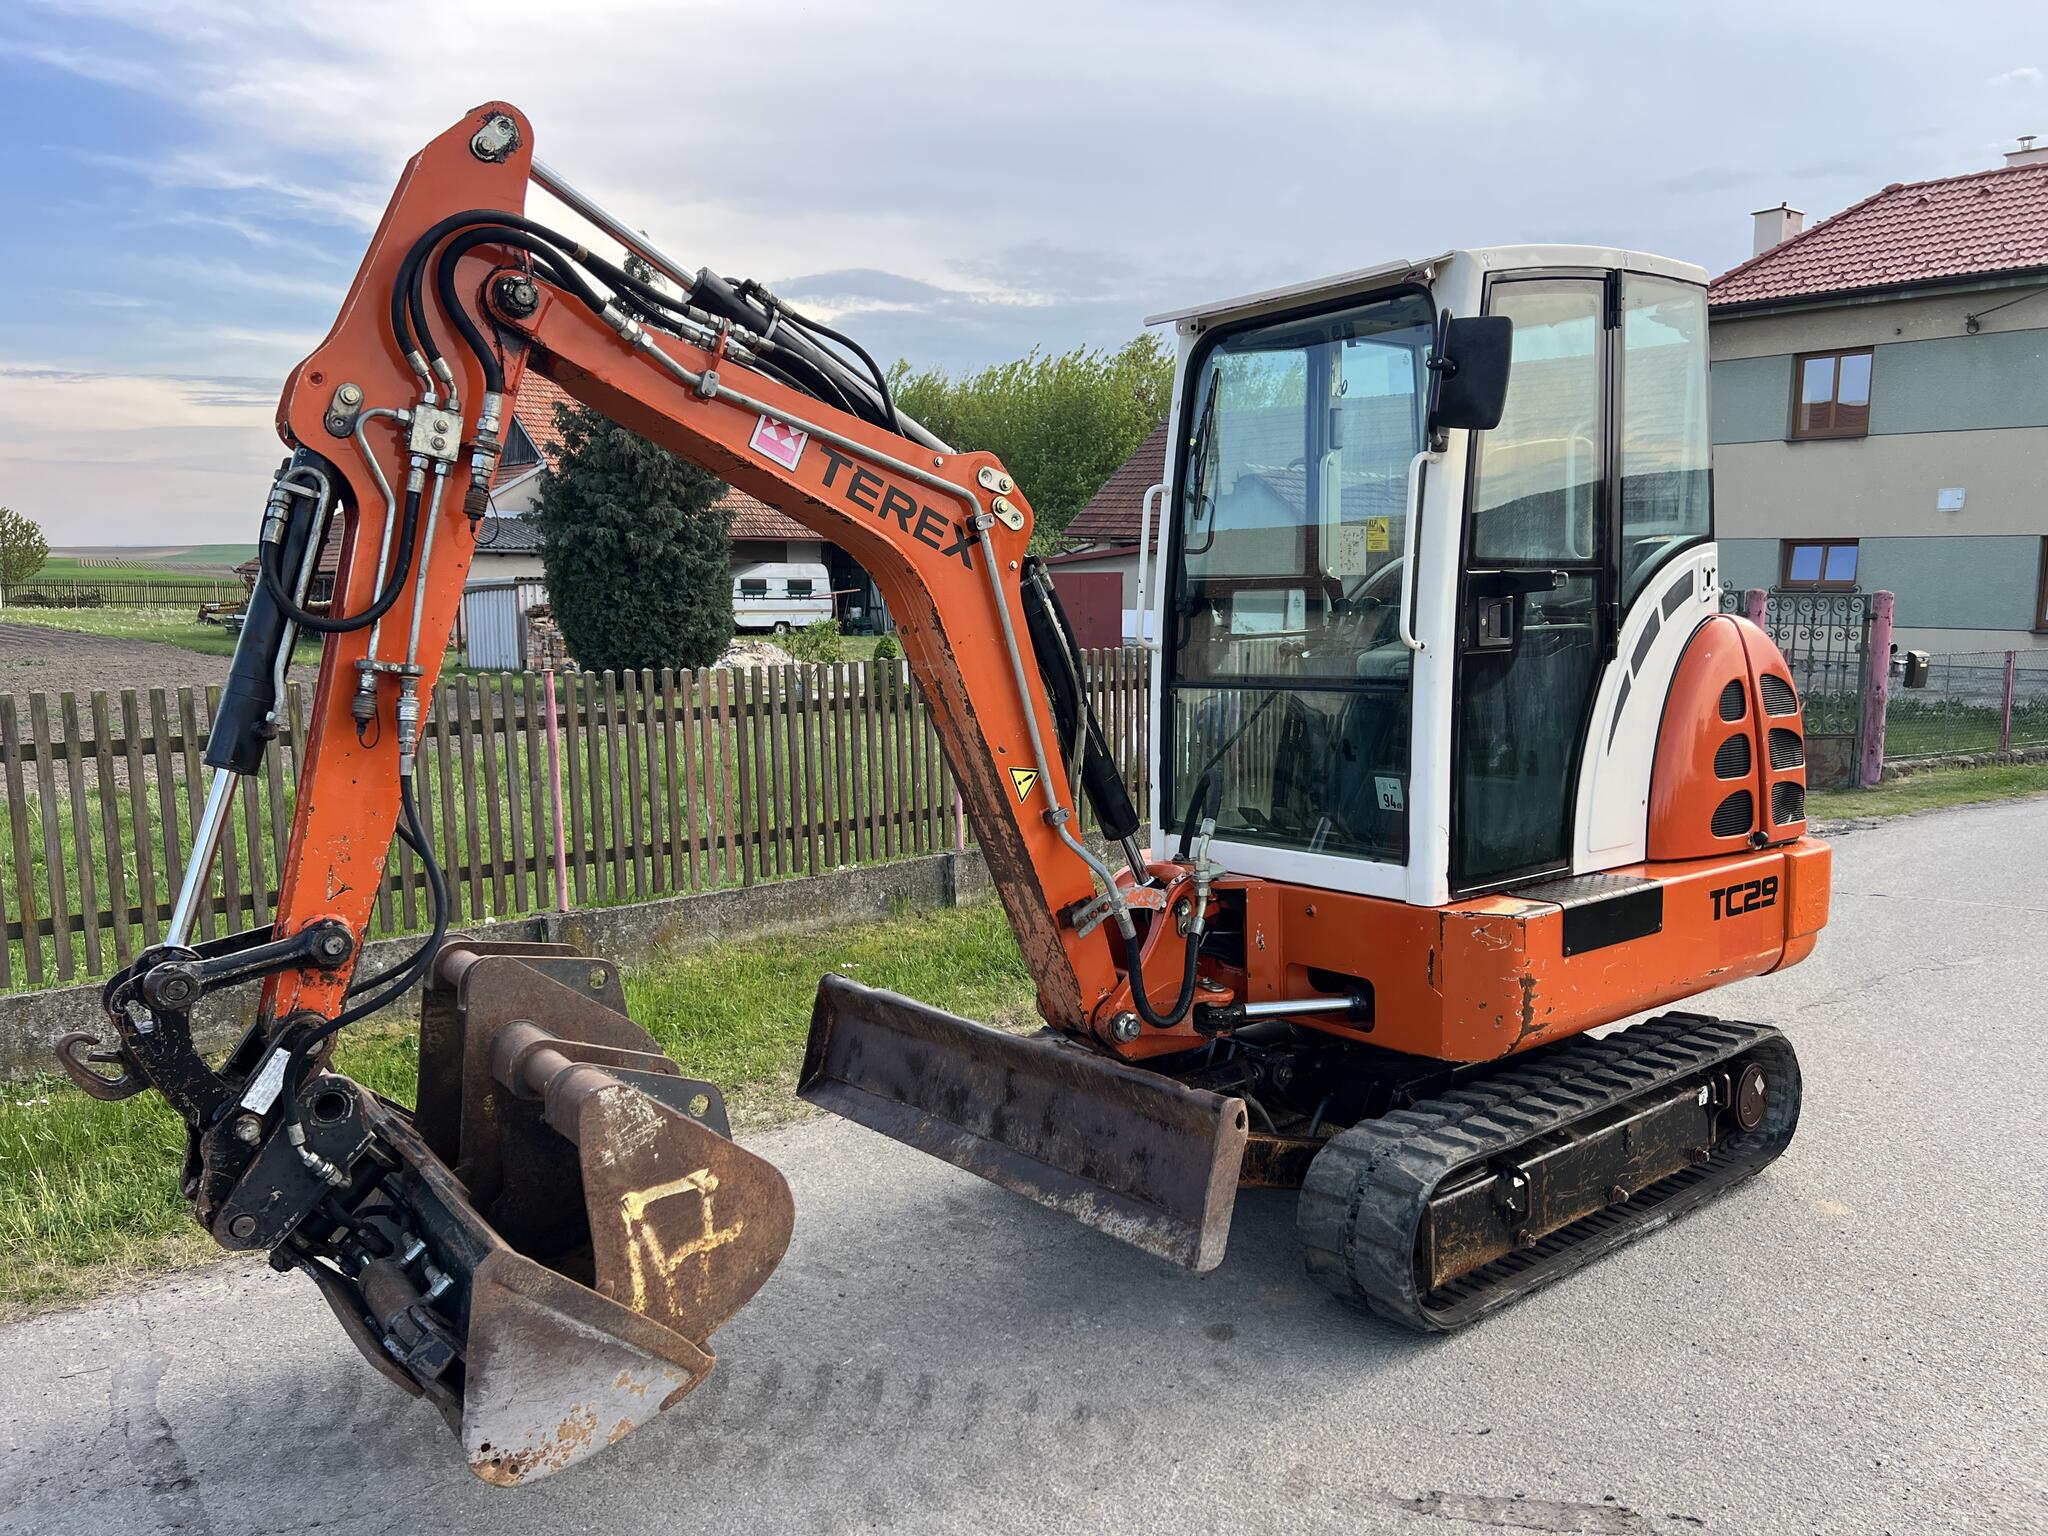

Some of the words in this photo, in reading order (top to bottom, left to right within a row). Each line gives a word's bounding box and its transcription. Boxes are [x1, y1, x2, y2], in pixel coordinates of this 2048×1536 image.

[819, 447, 979, 570] TEREX
[1383, 793, 1396, 808] 94
[1710, 875, 1778, 920] TC29
